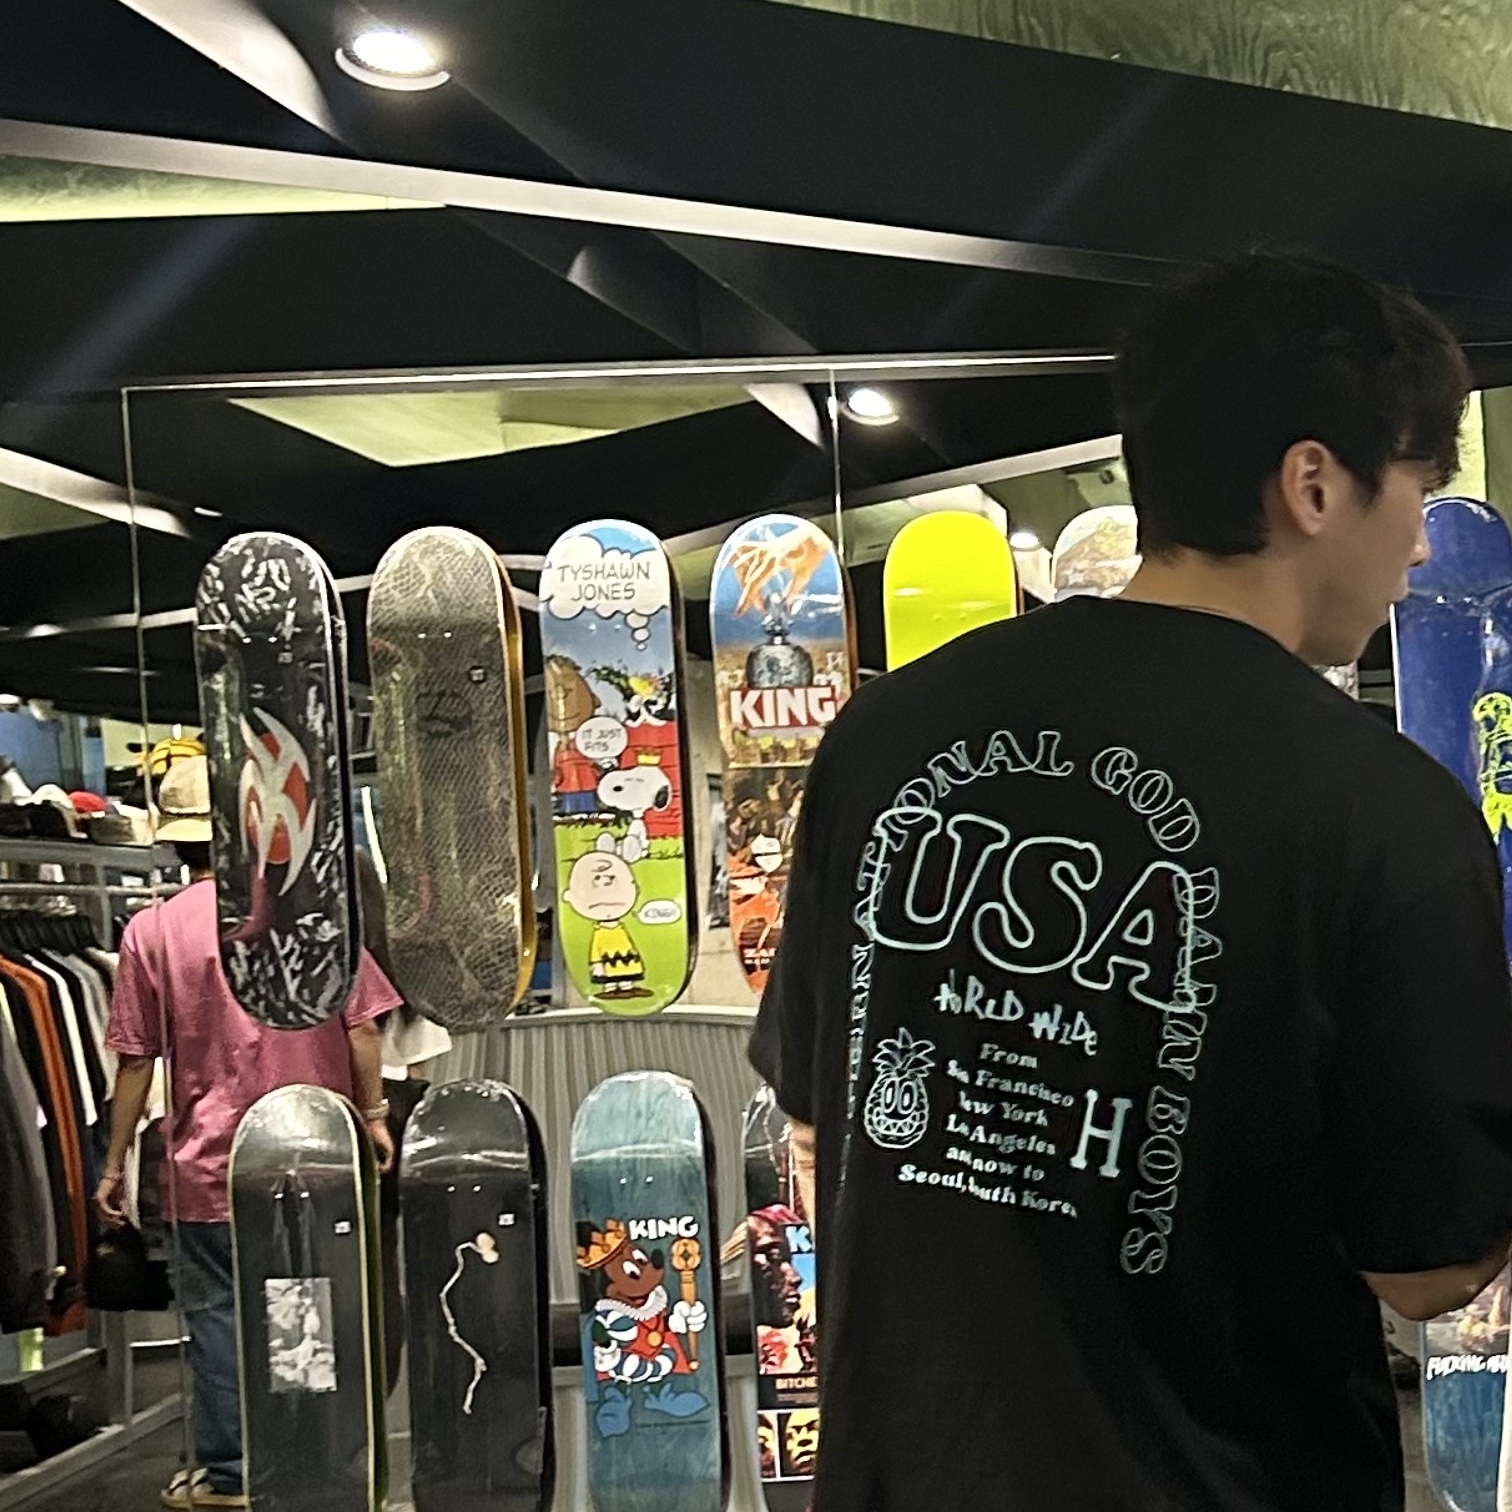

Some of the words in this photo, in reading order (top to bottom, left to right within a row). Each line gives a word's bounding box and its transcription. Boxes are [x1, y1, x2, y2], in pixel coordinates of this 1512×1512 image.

[558, 561, 650, 582] TYSHAWN
[571, 583, 636, 601] JONES
[730, 686, 836, 728] KING
[871, 805, 1197, 1013] USA
[980, 1043, 1038, 1069] From
[1000, 1101, 1048, 1126] York
[969, 1125, 1056, 1156] Angeles
[1069, 1088, 1134, 1179] H
[898, 1163, 967, 1193] Seoul,
[972, 1157, 1018, 1176] now
[1023, 1164, 1046, 1182] to
[1120, 1085, 1191, 1286] BOYS
[628, 1216, 698, 1240] KING
